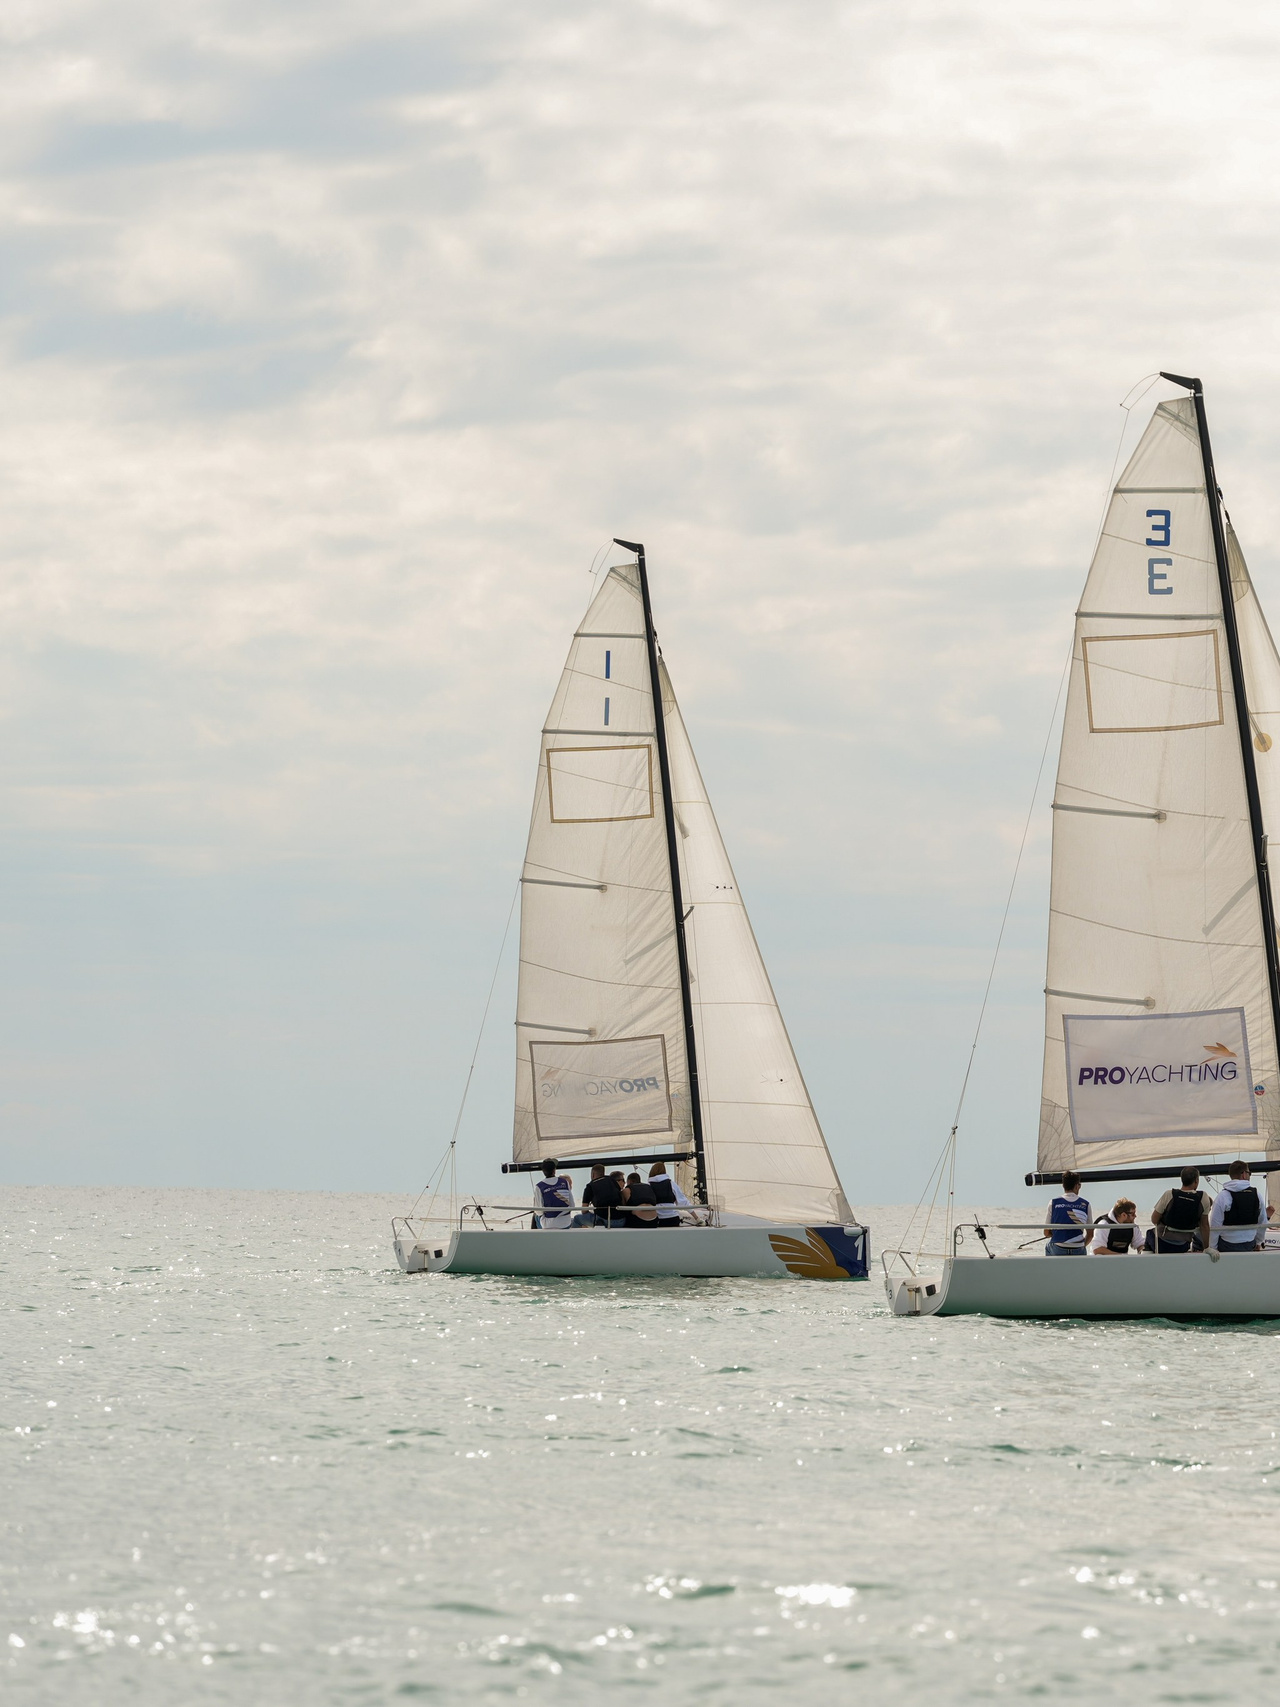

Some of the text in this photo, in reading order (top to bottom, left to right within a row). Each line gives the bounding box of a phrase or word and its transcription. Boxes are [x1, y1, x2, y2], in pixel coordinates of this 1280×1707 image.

[1145, 509, 1171, 546] 3
[1078, 1061, 1238, 1086] PROYACHTING
[854, 1235, 864, 1261] 1
[888, 1289, 893, 1300] 3
